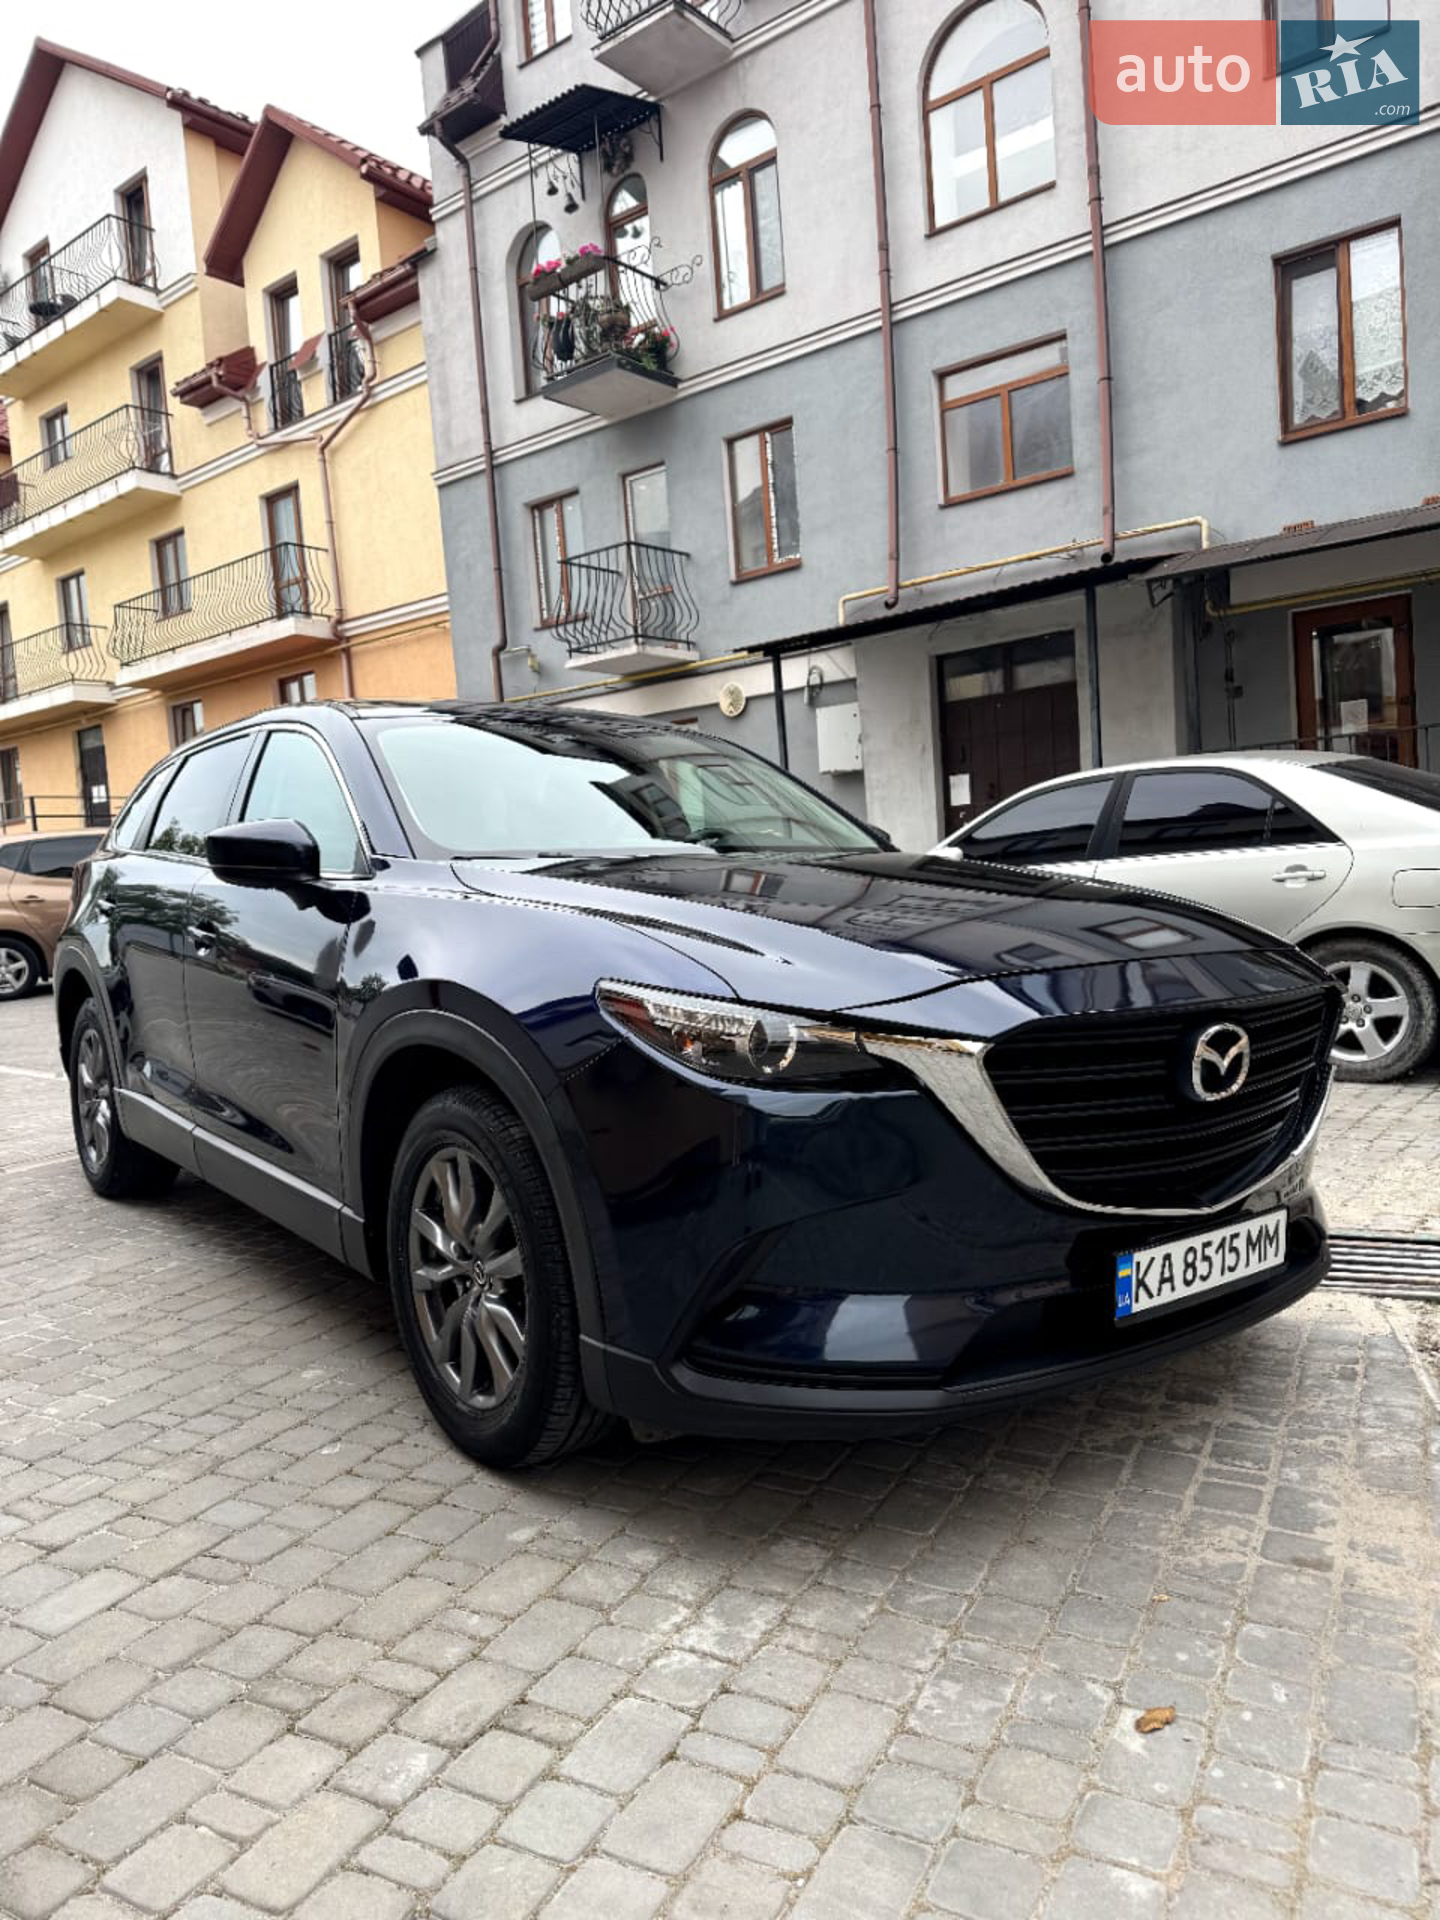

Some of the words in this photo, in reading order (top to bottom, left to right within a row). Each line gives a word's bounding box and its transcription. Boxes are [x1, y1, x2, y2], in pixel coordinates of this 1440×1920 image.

[1135, 1252, 1176, 1303] KA
[1183, 1232, 1241, 1287] 8515
[1245, 1219, 1281, 1269] MM
